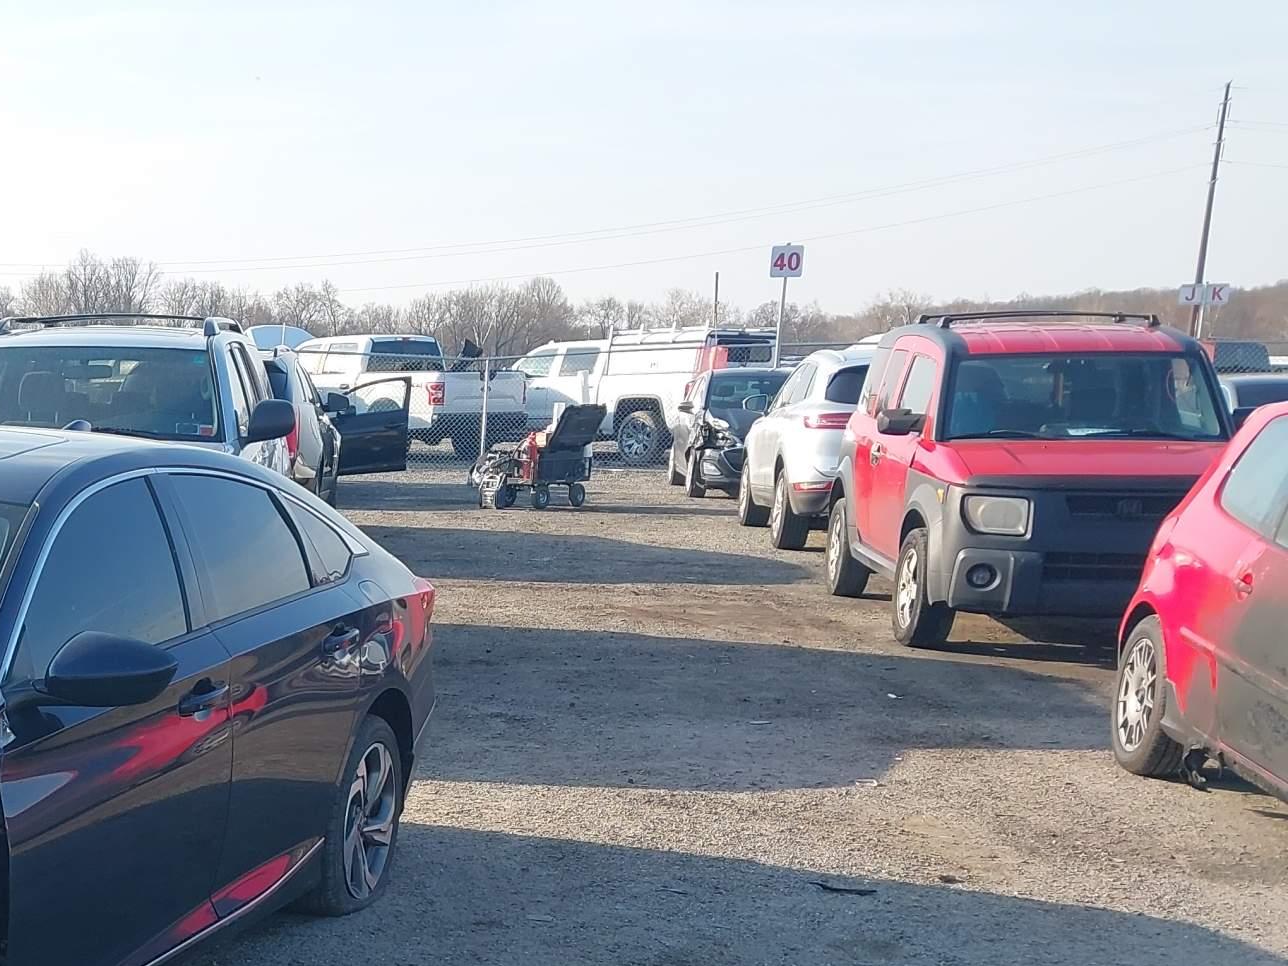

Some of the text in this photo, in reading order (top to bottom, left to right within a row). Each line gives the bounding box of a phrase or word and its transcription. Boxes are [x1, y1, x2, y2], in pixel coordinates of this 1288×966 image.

[773, 252, 801, 271] 40
[1185, 287, 1196, 301] J
[1212, 287, 1223, 301] K
